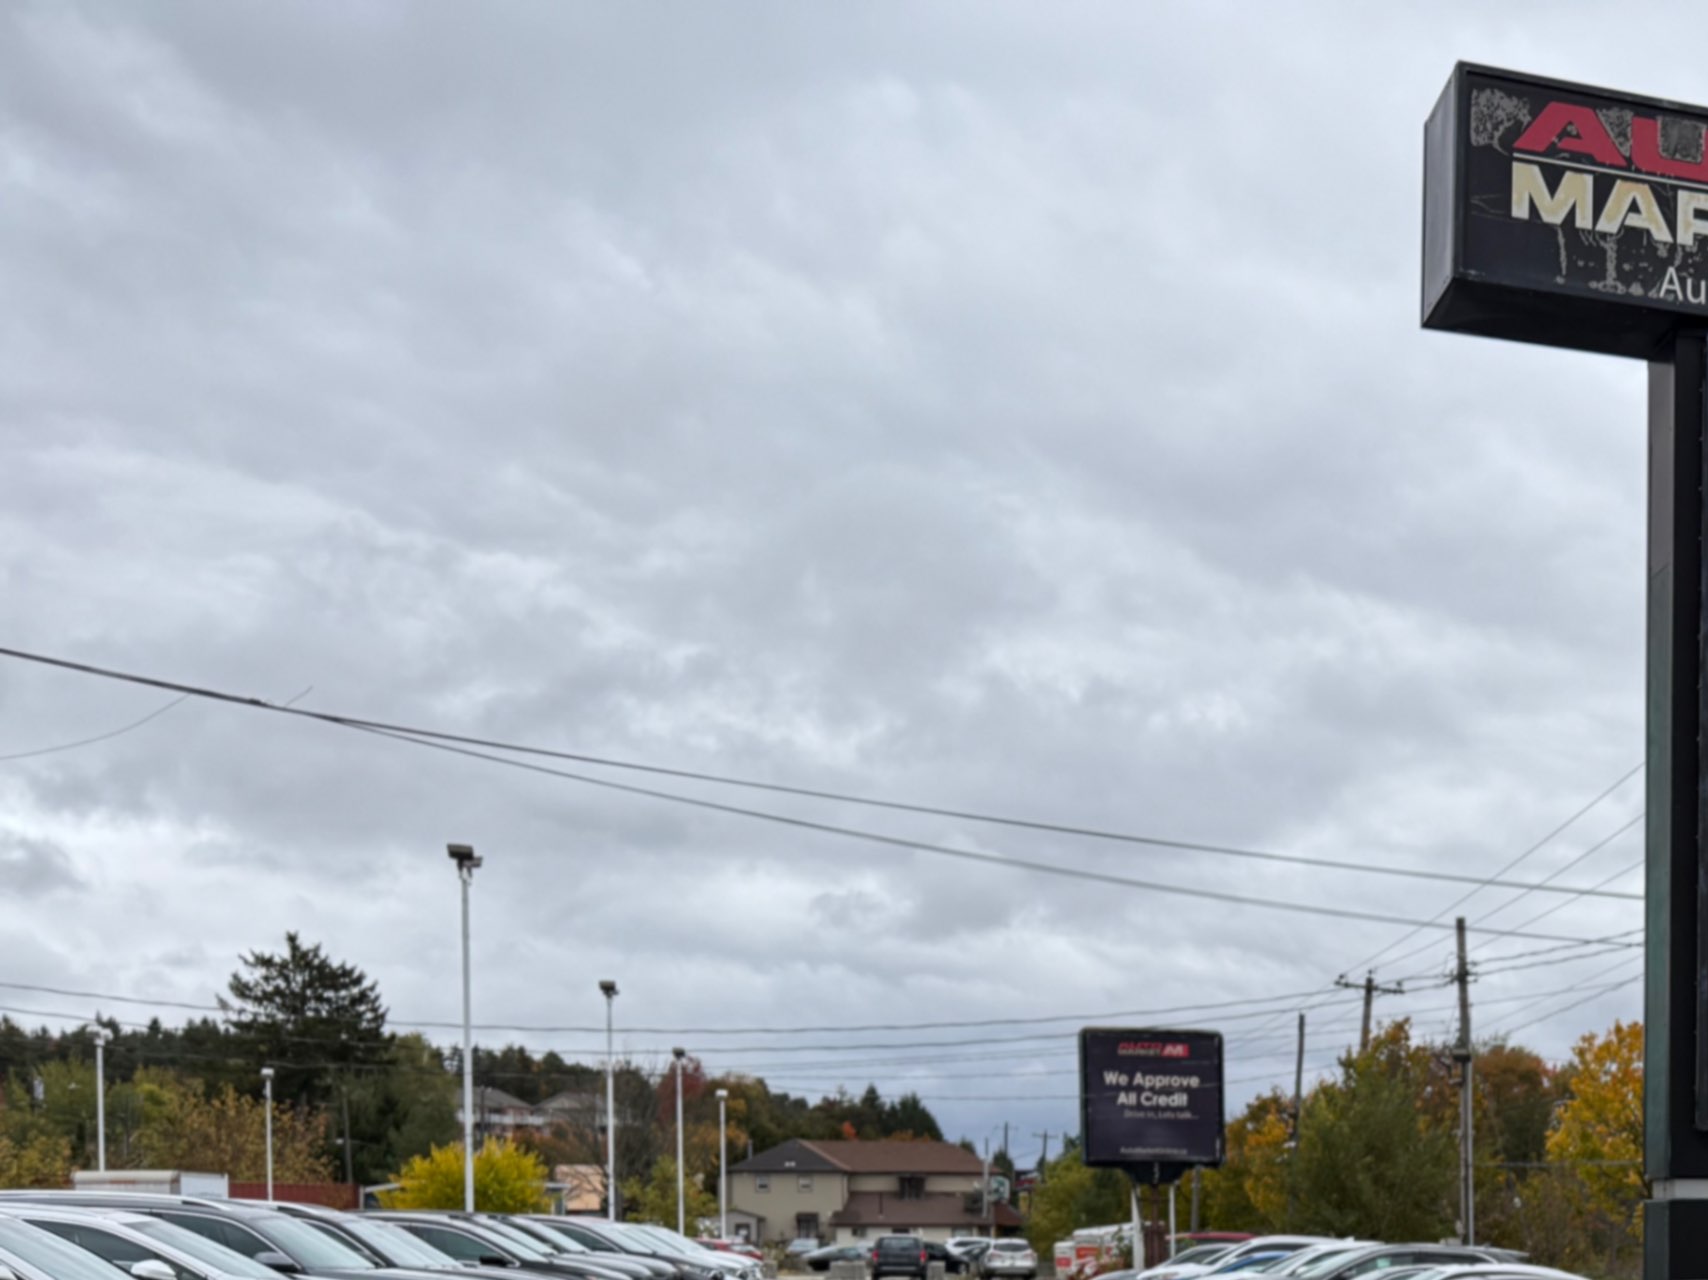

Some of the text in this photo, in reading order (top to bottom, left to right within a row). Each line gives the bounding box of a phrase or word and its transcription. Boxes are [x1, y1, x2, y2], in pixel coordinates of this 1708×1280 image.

[1103, 1070, 1200, 1089] We Approve
[1116, 1091, 1188, 1107] All Credit
